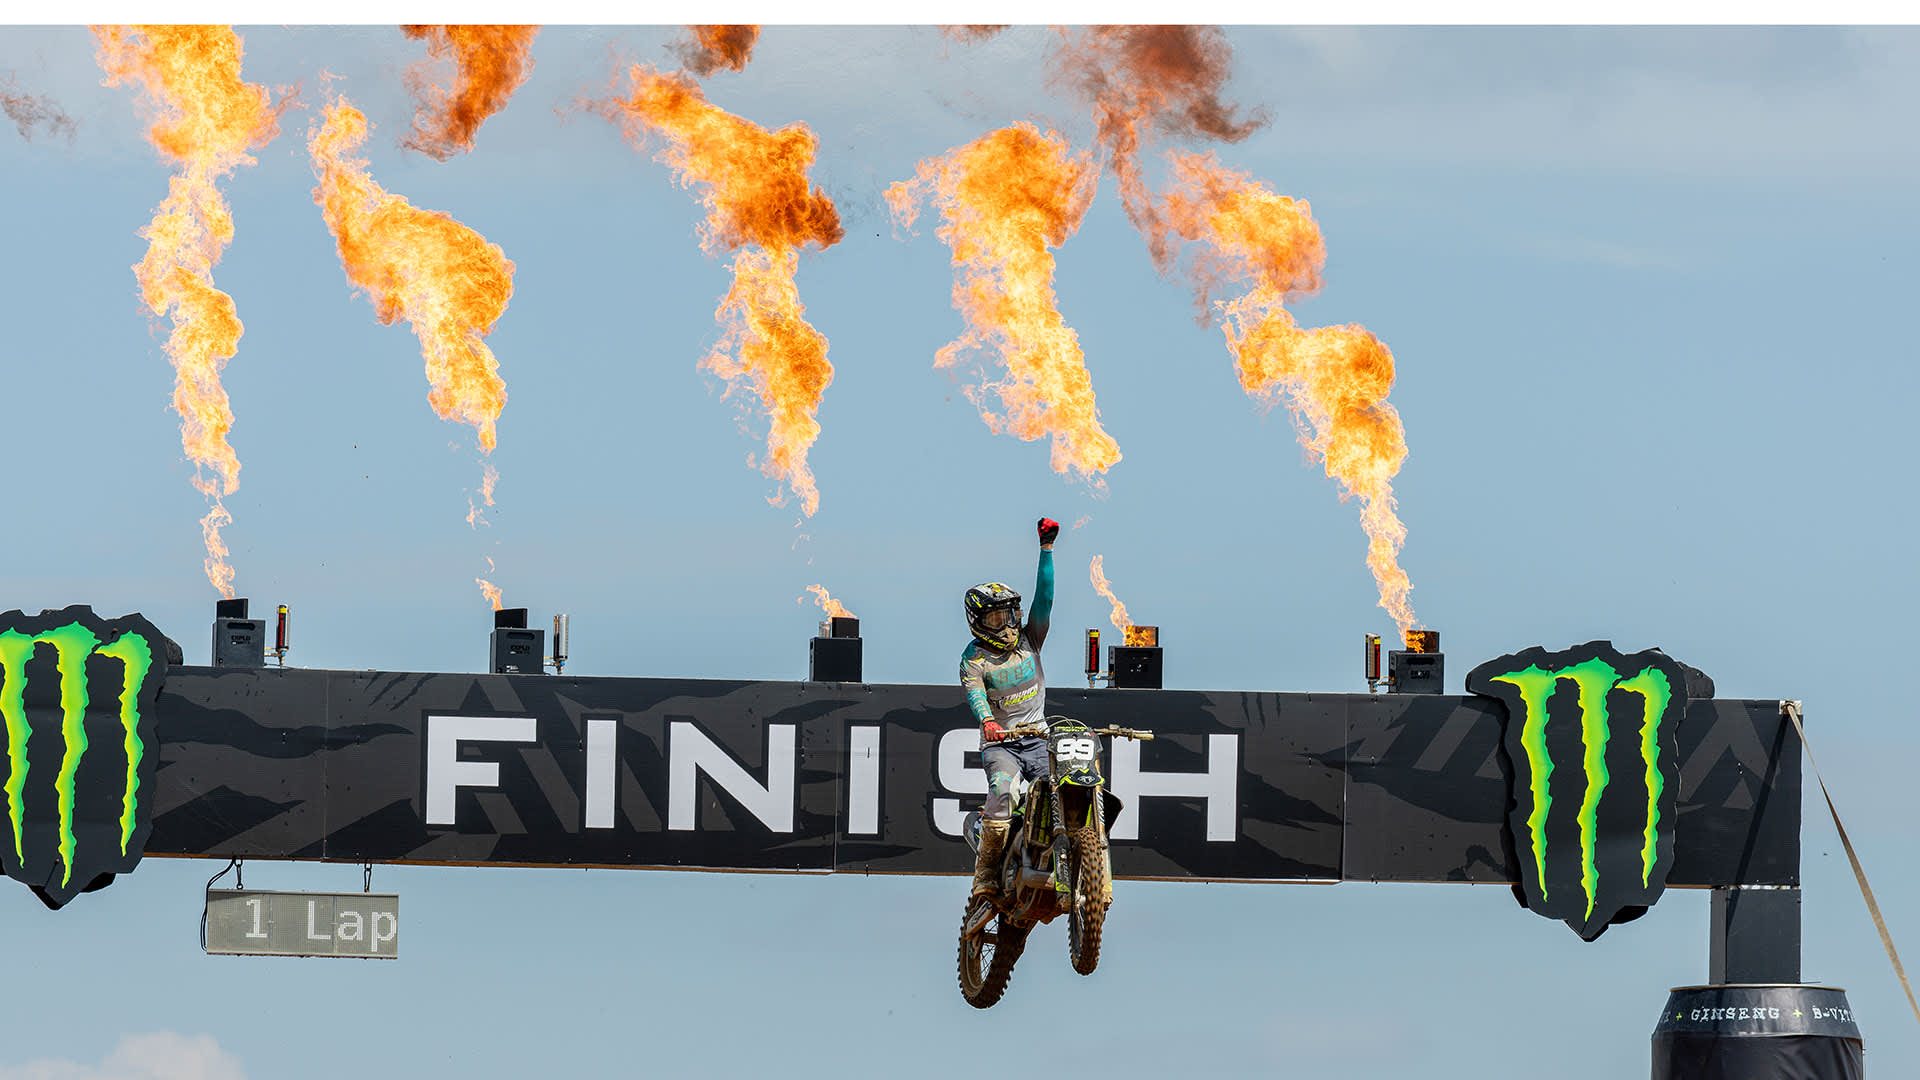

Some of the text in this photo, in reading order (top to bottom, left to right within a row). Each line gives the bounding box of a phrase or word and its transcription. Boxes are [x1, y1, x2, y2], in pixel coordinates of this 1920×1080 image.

[1056, 738, 1095, 762] 99
[245, 899, 397, 953] 1 Lap
[1691, 1006, 1780, 1023] GINSENG
